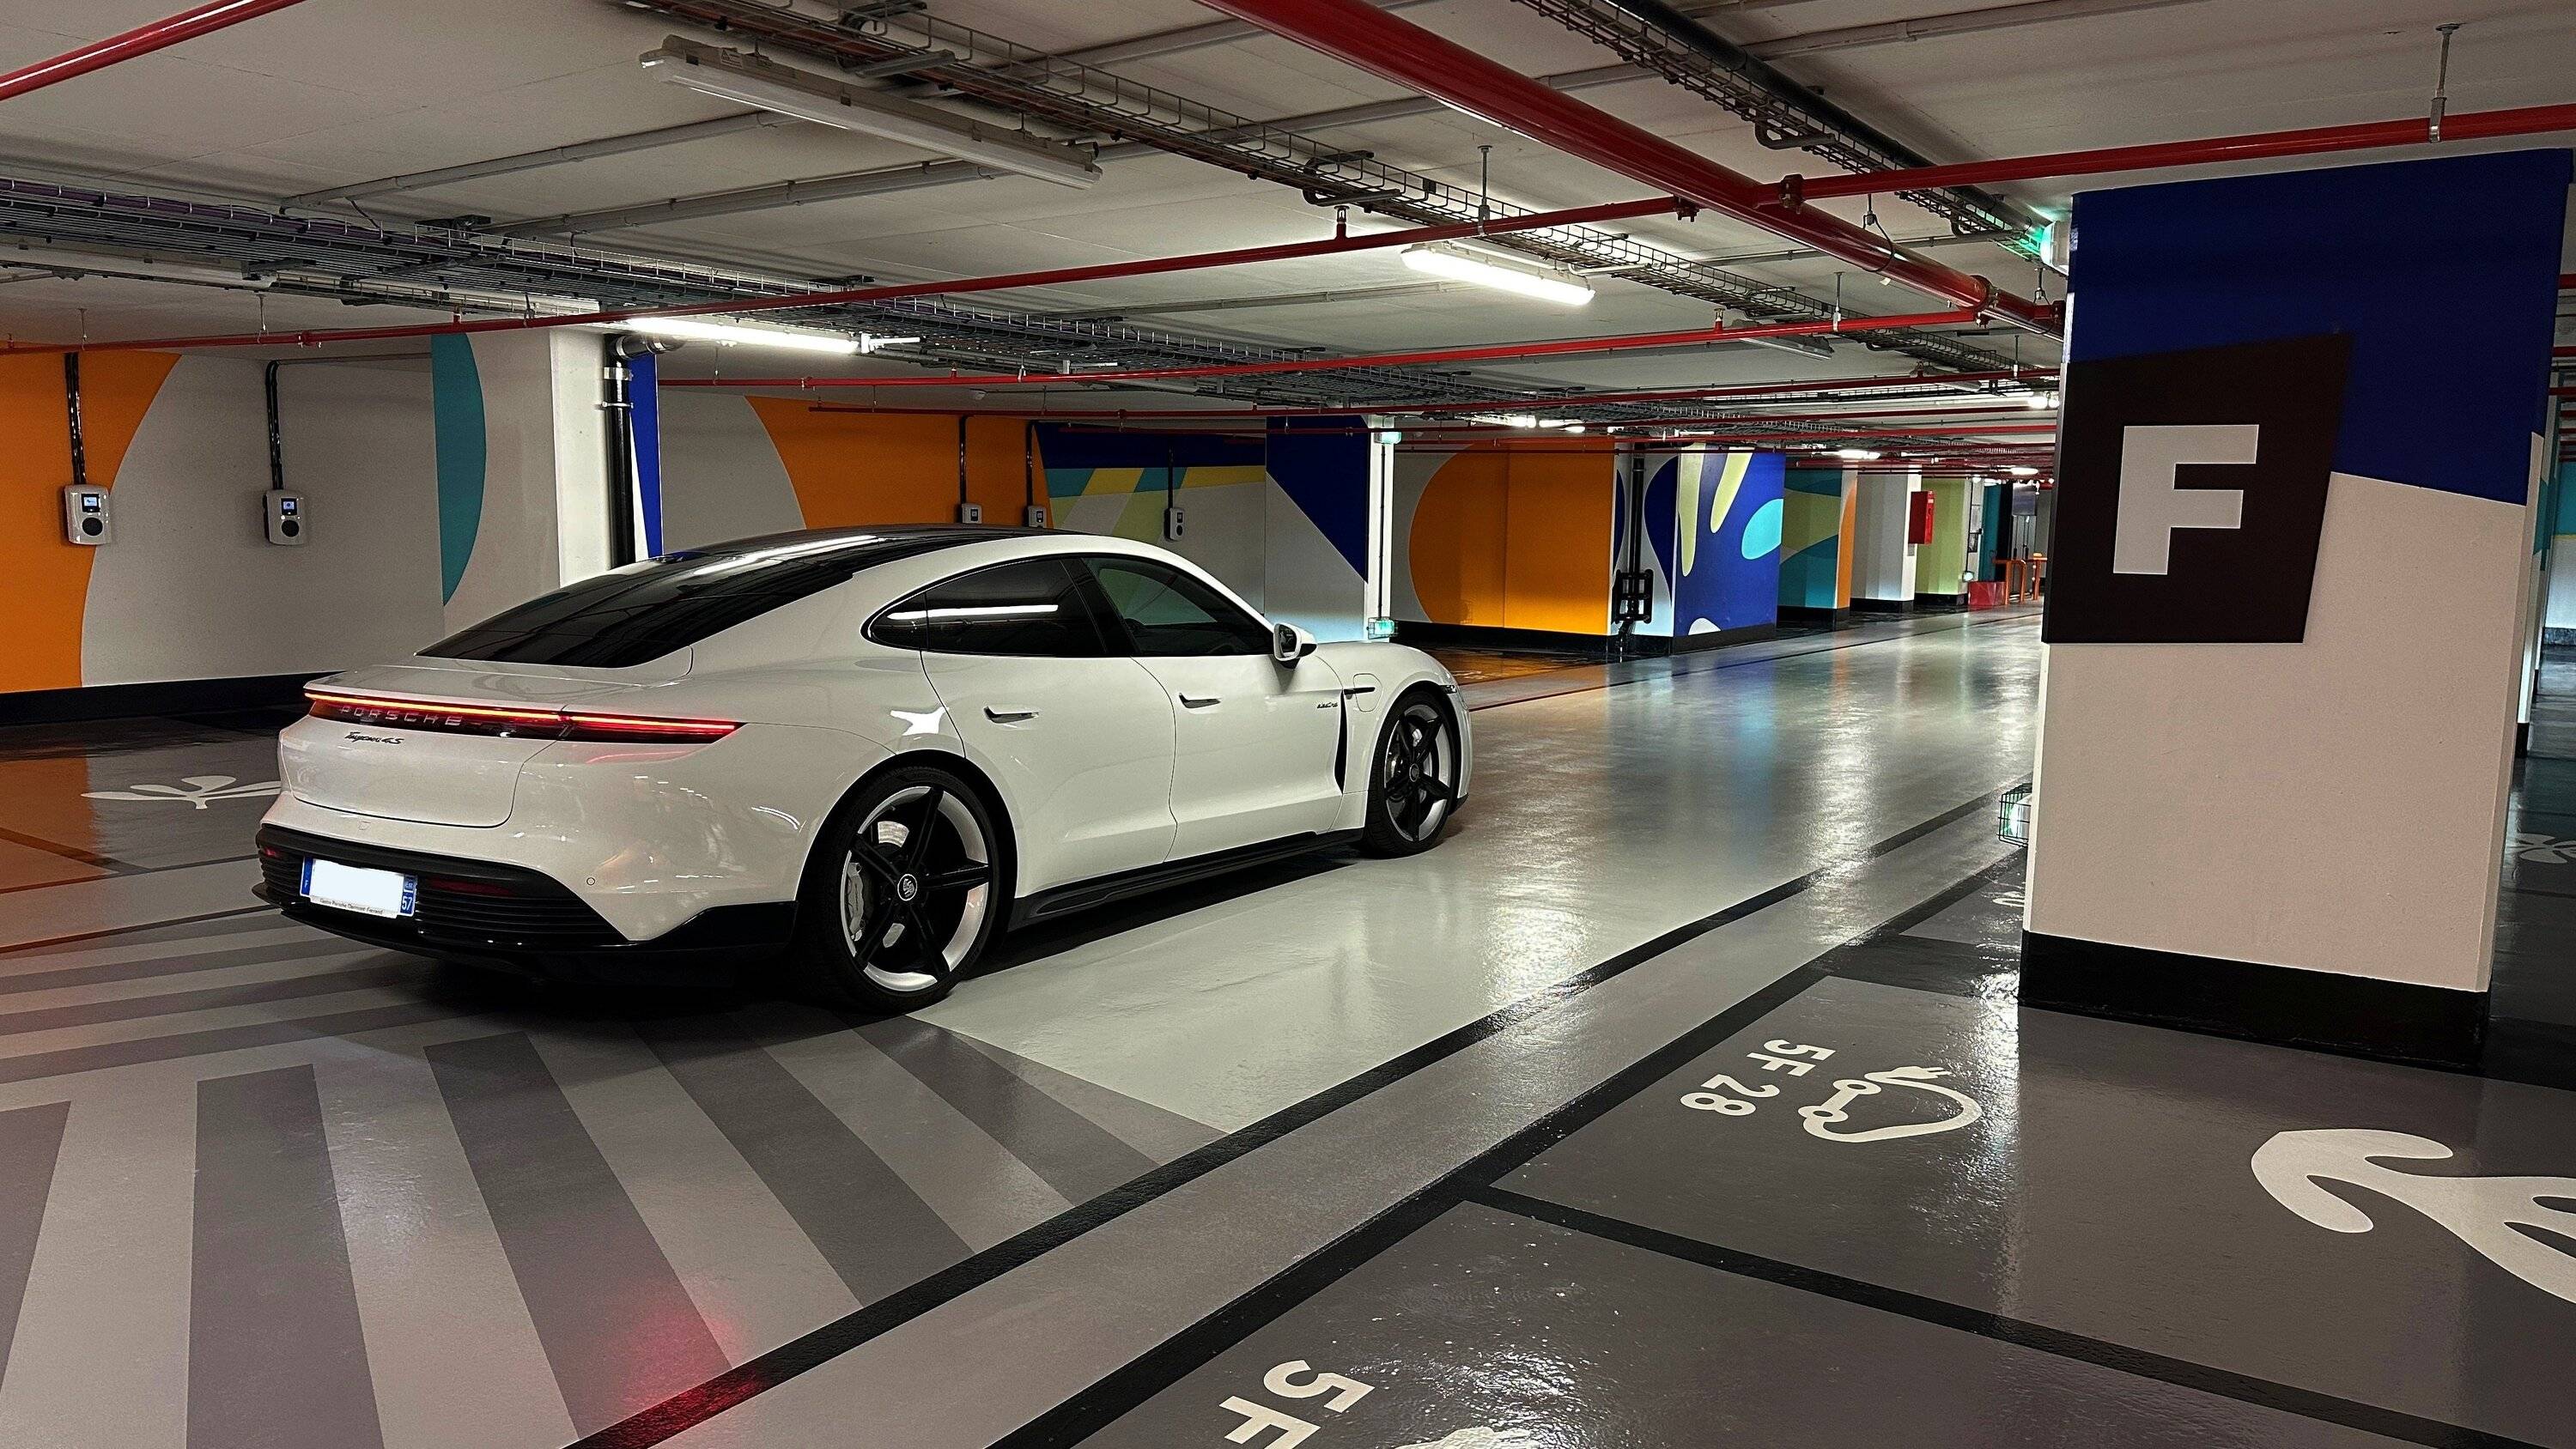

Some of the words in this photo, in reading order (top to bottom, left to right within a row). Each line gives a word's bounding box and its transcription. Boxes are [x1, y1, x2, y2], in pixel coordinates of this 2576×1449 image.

[2113, 424, 2259, 575] F
[338, 705, 463, 726] PORSCHE
[401, 895, 413, 911] 57
[1746, 1039, 1837, 1077] 5F
[1680, 1074, 1780, 1116] 28
[1218, 1359, 1376, 1449] 5F
